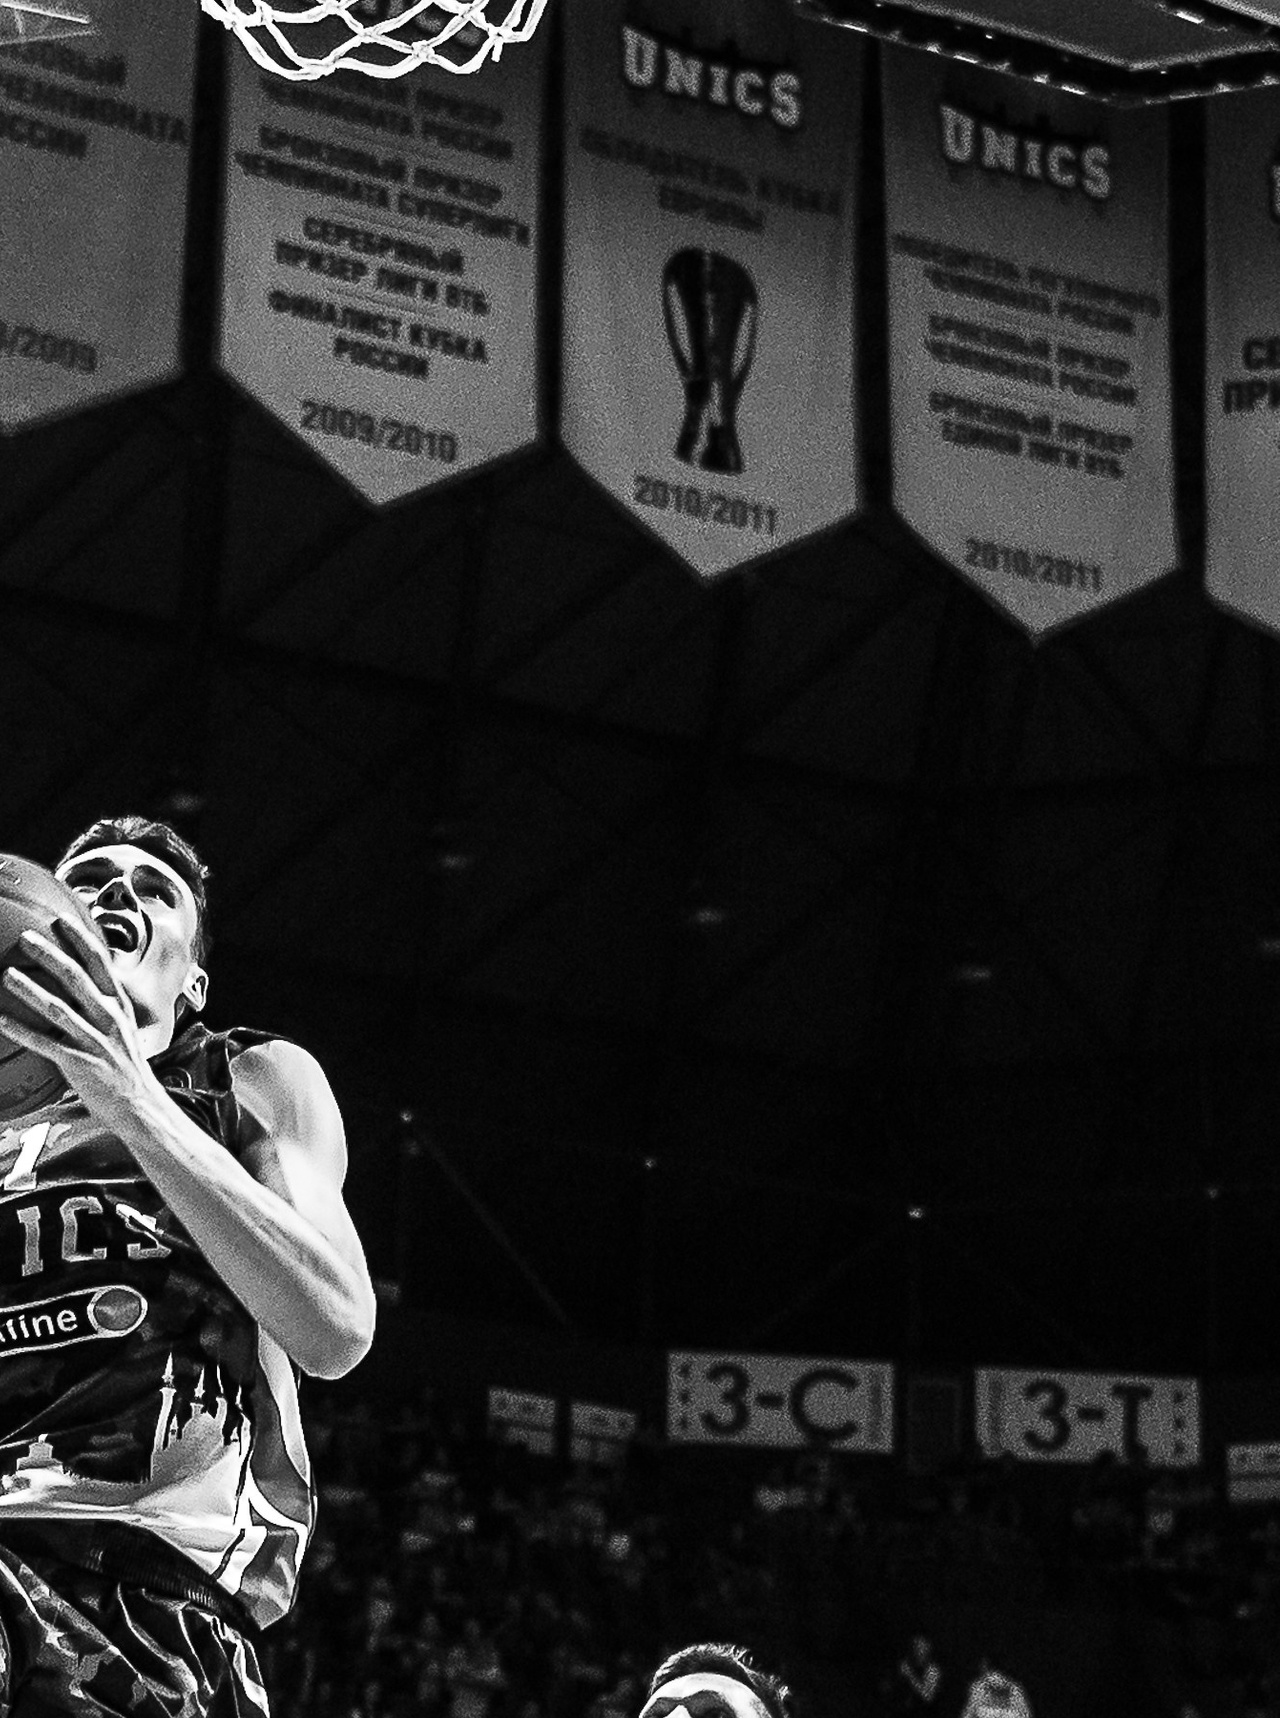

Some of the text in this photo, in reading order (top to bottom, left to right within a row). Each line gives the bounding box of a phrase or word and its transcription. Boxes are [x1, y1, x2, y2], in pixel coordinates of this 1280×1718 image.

[623, 23, 800, 127] UNICS
[940, 104, 1110, 199] UNICS
[275, 242, 367, 281] ПРИЗЕР
[268, 289, 488, 362] ФИНАЛИСТ КУБКА
[334, 336, 427, 377] РОССИИ
[302, 399, 457, 462] 2009/2010
[634, 475, 777, 534] 2010/2011
[966, 538, 1101, 594] 2010/2011
